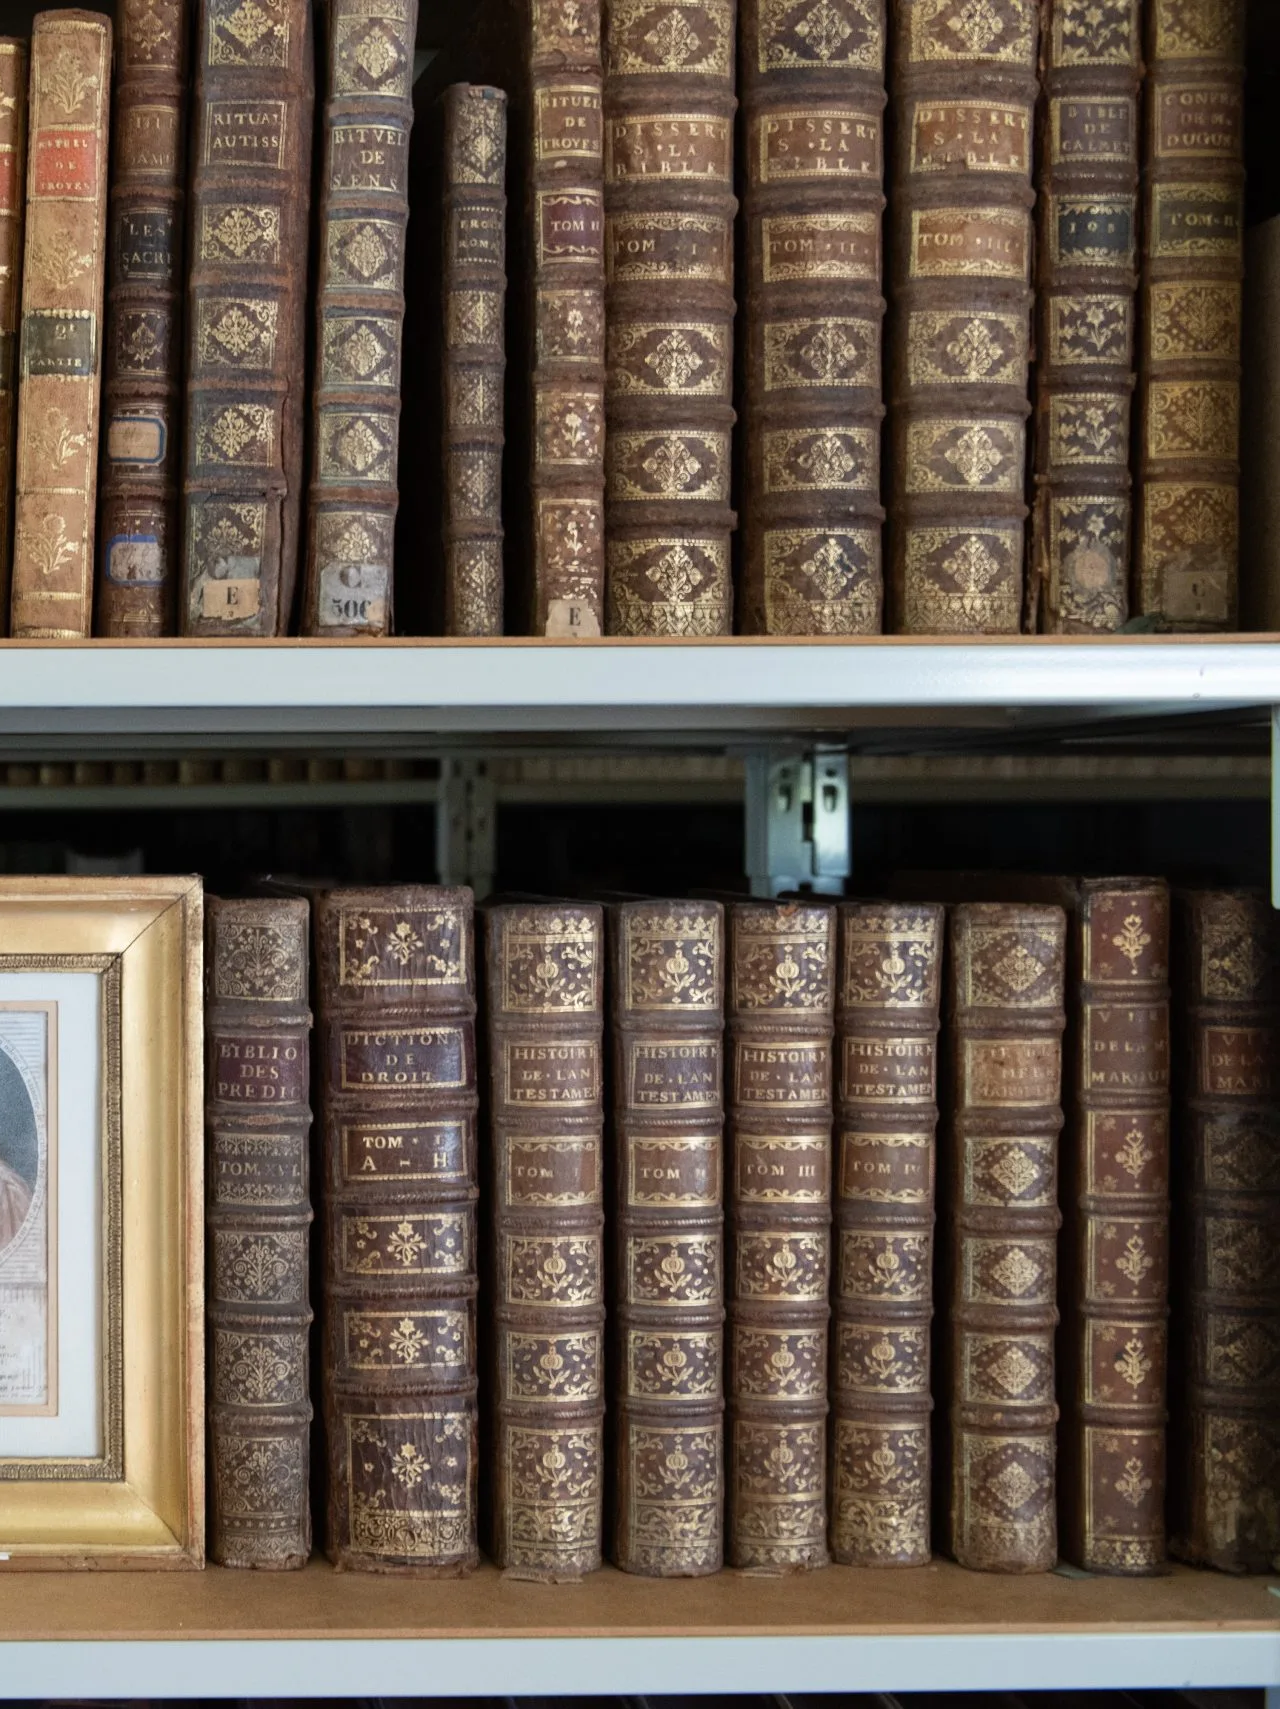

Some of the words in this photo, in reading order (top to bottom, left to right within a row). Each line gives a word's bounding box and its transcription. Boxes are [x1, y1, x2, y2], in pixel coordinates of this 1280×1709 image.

[565, 116, 586, 127] DE
[920, 108, 1026, 130] DISSERT
[767, 118, 877, 140] DISSERT
[1084, 123, 1112, 135] DE
[38, 138, 88, 149] RITUEL
[213, 134, 280, 148] AUTISS
[543, 138, 599, 150] TROYES
[361, 151, 385, 165] DE
[55, 161, 76, 170] DE
[617, 160, 717, 176] BIBLE
[333, 174, 398, 190] SENS
[129, 224, 166, 237] LES
[551, 220, 584, 232] TOM
[919, 232, 964, 246] TOM
[226, 586, 239, 605] E
[568, 607, 582, 626] E
[221, 1044, 298, 1060] BIBLIO
[385, 1053, 416, 1067] DE
[240, 1065, 279, 1080] DES
[361, 1071, 433, 1084] DROIT
[219, 1083, 301, 1099] PREDIC
[363, 1136, 404, 1149] TOM
[361, 1156, 378, 1171] A
[433, 1152, 449, 1168] H
[853, 1160, 891, 1174] TOM
[515, 1166, 554, 1178] TOM
[640, 1167, 680, 1180] TOM
[746, 1164, 785, 1176] TOM
